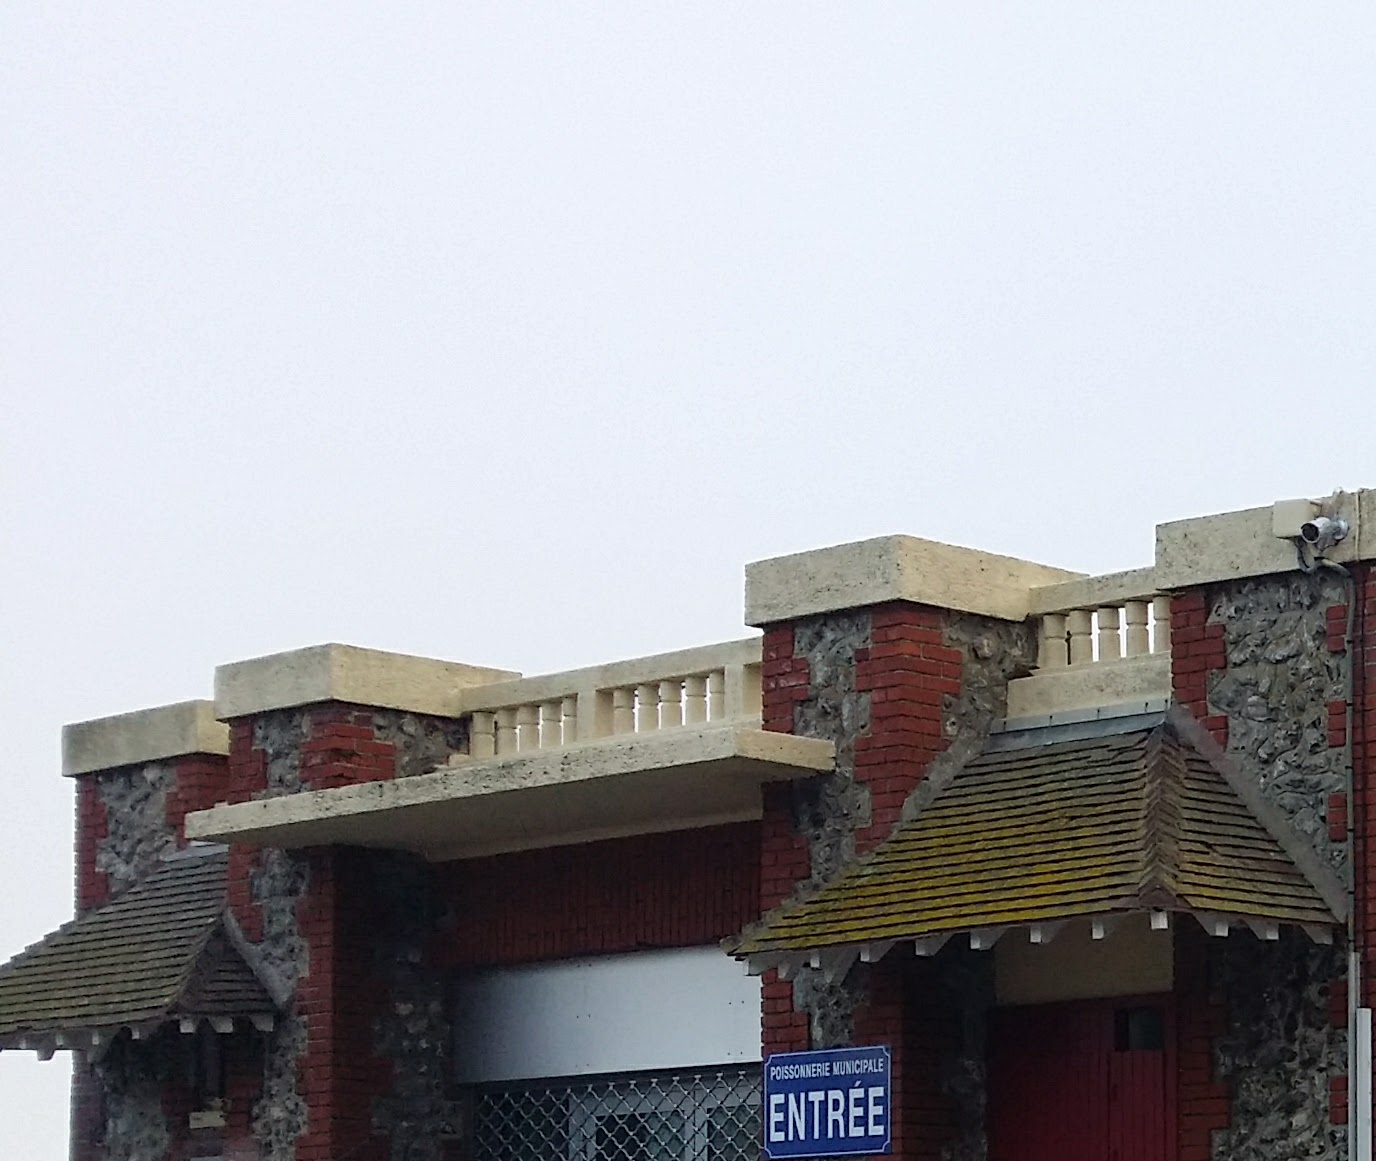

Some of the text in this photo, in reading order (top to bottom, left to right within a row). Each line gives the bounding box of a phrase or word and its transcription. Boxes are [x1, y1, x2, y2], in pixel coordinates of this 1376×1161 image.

[770, 1058, 884, 1081] POISSONNERIE MUNICIPALE
[769, 1080, 885, 1142] ENTRÉE
